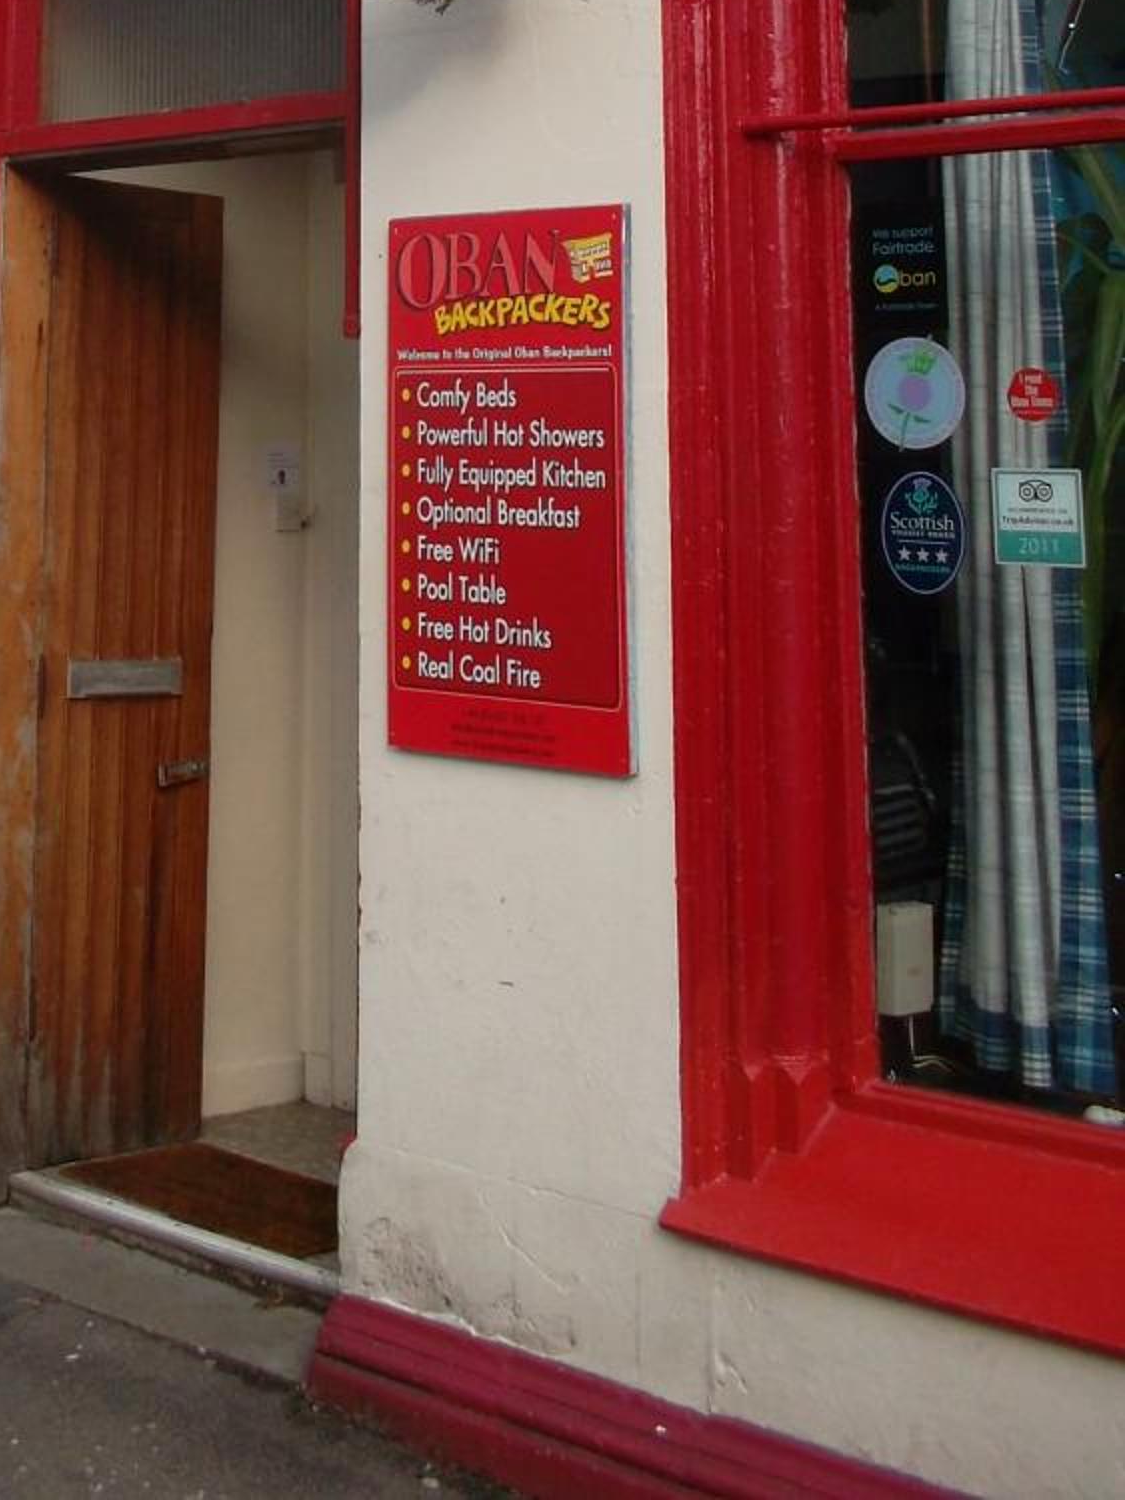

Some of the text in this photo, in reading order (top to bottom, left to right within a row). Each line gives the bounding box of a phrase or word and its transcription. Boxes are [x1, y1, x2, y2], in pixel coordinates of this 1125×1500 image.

[397, 229, 560, 309] OBAN
[435, 293, 611, 335] BACKPACKERS
[396, 344, 612, 361] Welcome to the Original Oban Backpackers!
[416, 377, 516, 415] Comfy Beds
[417, 417, 604, 447] Powerful Hot Showers
[417, 455, 606, 493] Fully Equipped Kitchen
[416, 495, 580, 530] Optional Breakfast
[890, 510, 955, 531] Scottish
[417, 536, 500, 564] Free WiFi
[1018, 536, 1059, 556] 2011
[417, 572, 506, 604] Pool Table
[417, 612, 551, 649] Free Hot Drinks
[417, 651, 540, 688] Real Coal Fire
